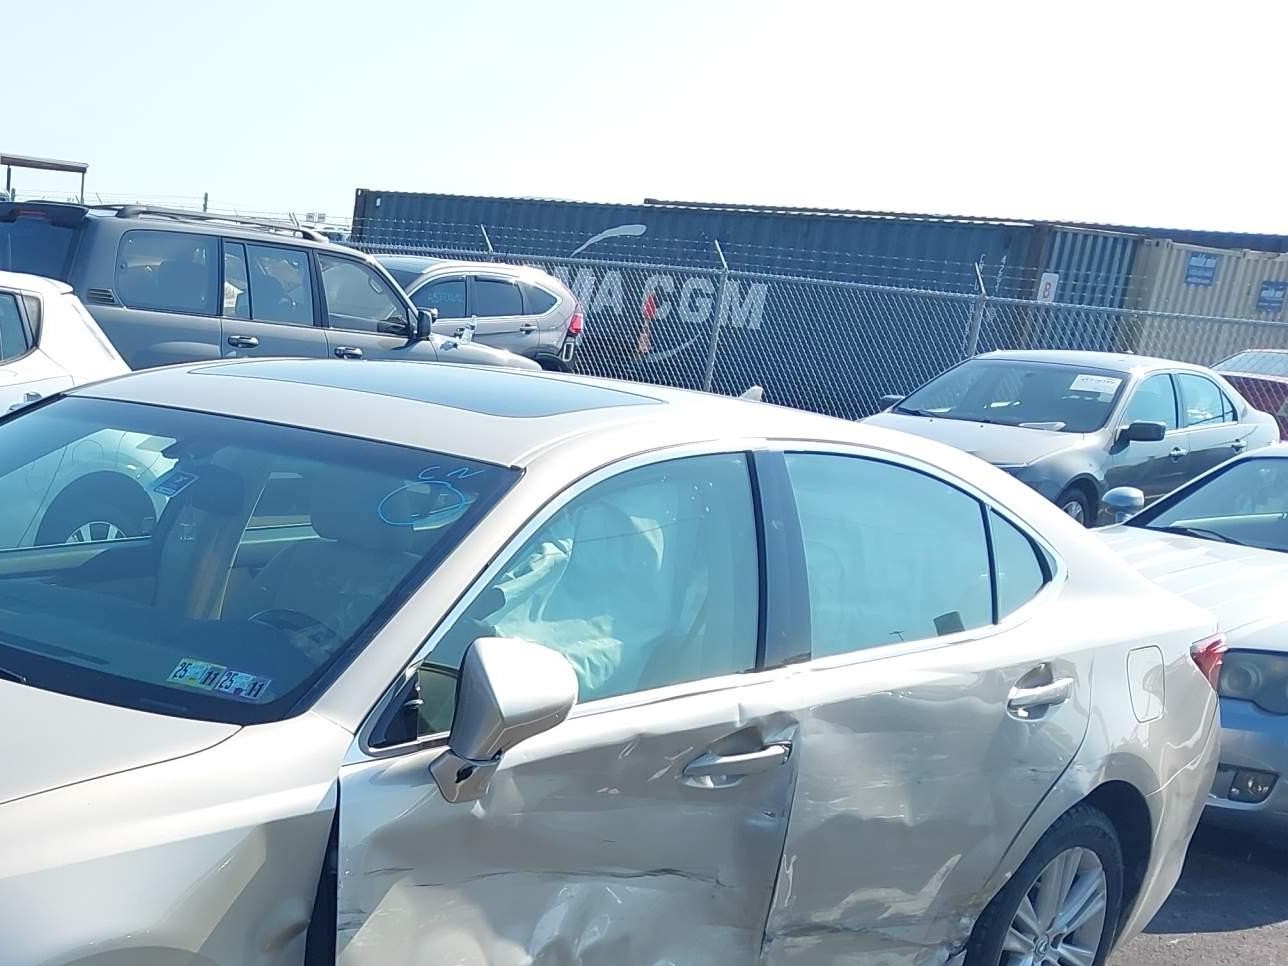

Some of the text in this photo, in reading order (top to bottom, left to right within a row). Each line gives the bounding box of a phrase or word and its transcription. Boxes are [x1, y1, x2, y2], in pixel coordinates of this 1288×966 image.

[555, 267, 768, 330] MA CGM
[174, 662, 220, 686] 25 11
[219, 672, 265, 698] 25 11
